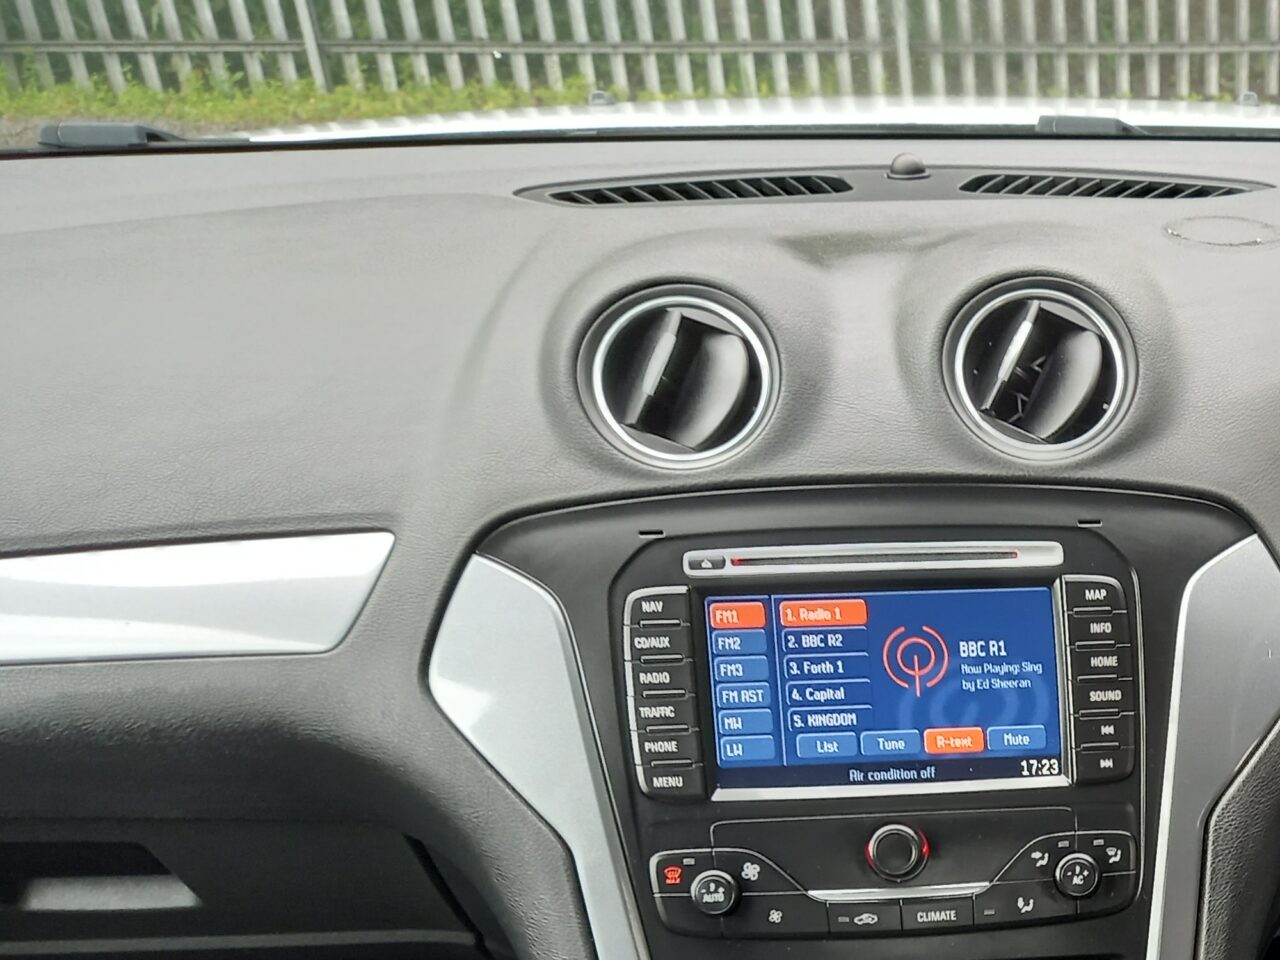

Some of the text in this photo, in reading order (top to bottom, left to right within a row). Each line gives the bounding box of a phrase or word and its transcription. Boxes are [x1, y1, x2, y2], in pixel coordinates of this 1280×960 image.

[1085, 589, 1107, 600] MAP
[641, 600, 664, 613] NAV
[715, 610, 739, 624] FM1
[800, 607, 832, 620] Radio
[834, 607, 842, 620] 1
[1090, 622, 1112, 634] INFO
[634, 636, 671, 649] CD/AUX
[718, 636, 741, 650] FM2
[787, 634, 843, 649] 2. BBC R2
[959, 640, 1007, 658] BBC R1
[789, 660, 844, 675] 3. Forth 1
[1090, 655, 1118, 668] HOME
[720, 663, 744, 676] FM3
[961, 661, 1043, 676] Now Playing: Sing
[639, 672, 670, 684] RADIO
[962, 678, 1032, 692] by Ed Sheeran
[722, 690, 740, 703] FM
[791, 687, 845, 702] 4. Capital
[1089, 690, 1122, 702] SOUND
[639, 706, 676, 719] TRAFFIC
[724, 717, 742, 730] MW
[808, 712, 857, 727] KINGDOM
[878, 738, 906, 750] Tune
[936, 735, 973, 749] R-text
[1004, 733, 1031, 746] Mute
[644, 740, 678, 753] PHONE
[726, 743, 743, 757] LW
[816, 740, 840, 753] List
[1020, 758, 1060, 776] 17:23
[850, 766, 937, 782] Air condition off
[652, 776, 683, 788] MENU
[702, 892, 725, 903] AUTO
[916, 909, 958, 924] CLIMATE
